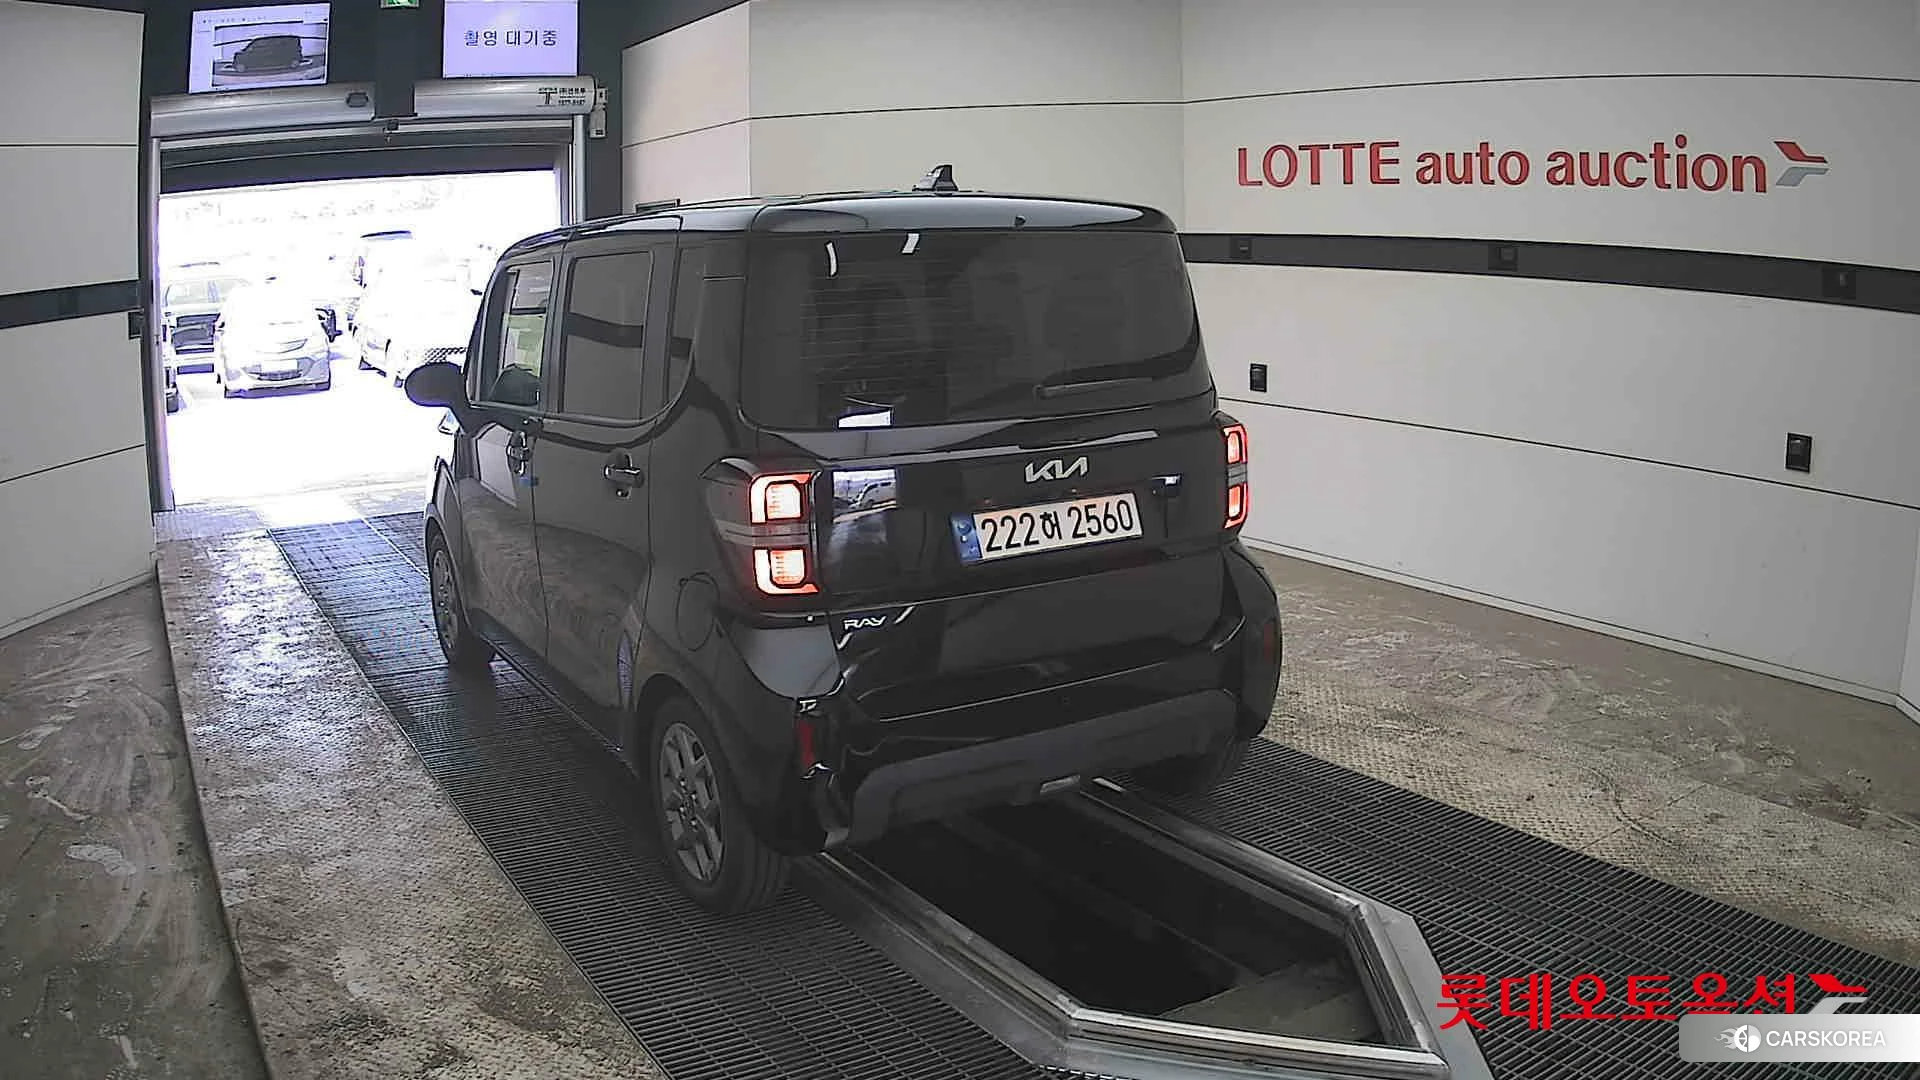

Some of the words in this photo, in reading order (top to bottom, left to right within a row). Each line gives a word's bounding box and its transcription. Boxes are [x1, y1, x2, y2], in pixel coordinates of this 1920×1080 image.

[464, 29, 498, 47] 촬영
[506, 29, 557, 47] 대기중
[1237, 141, 1400, 188] LOTTE
[1415, 140, 1530, 186] auto
[1546, 134, 1767, 194] auction
[981, 512, 1063, 553] 222허
[1067, 499, 1133, 540] 2560
[843, 615, 887, 631] RAY
